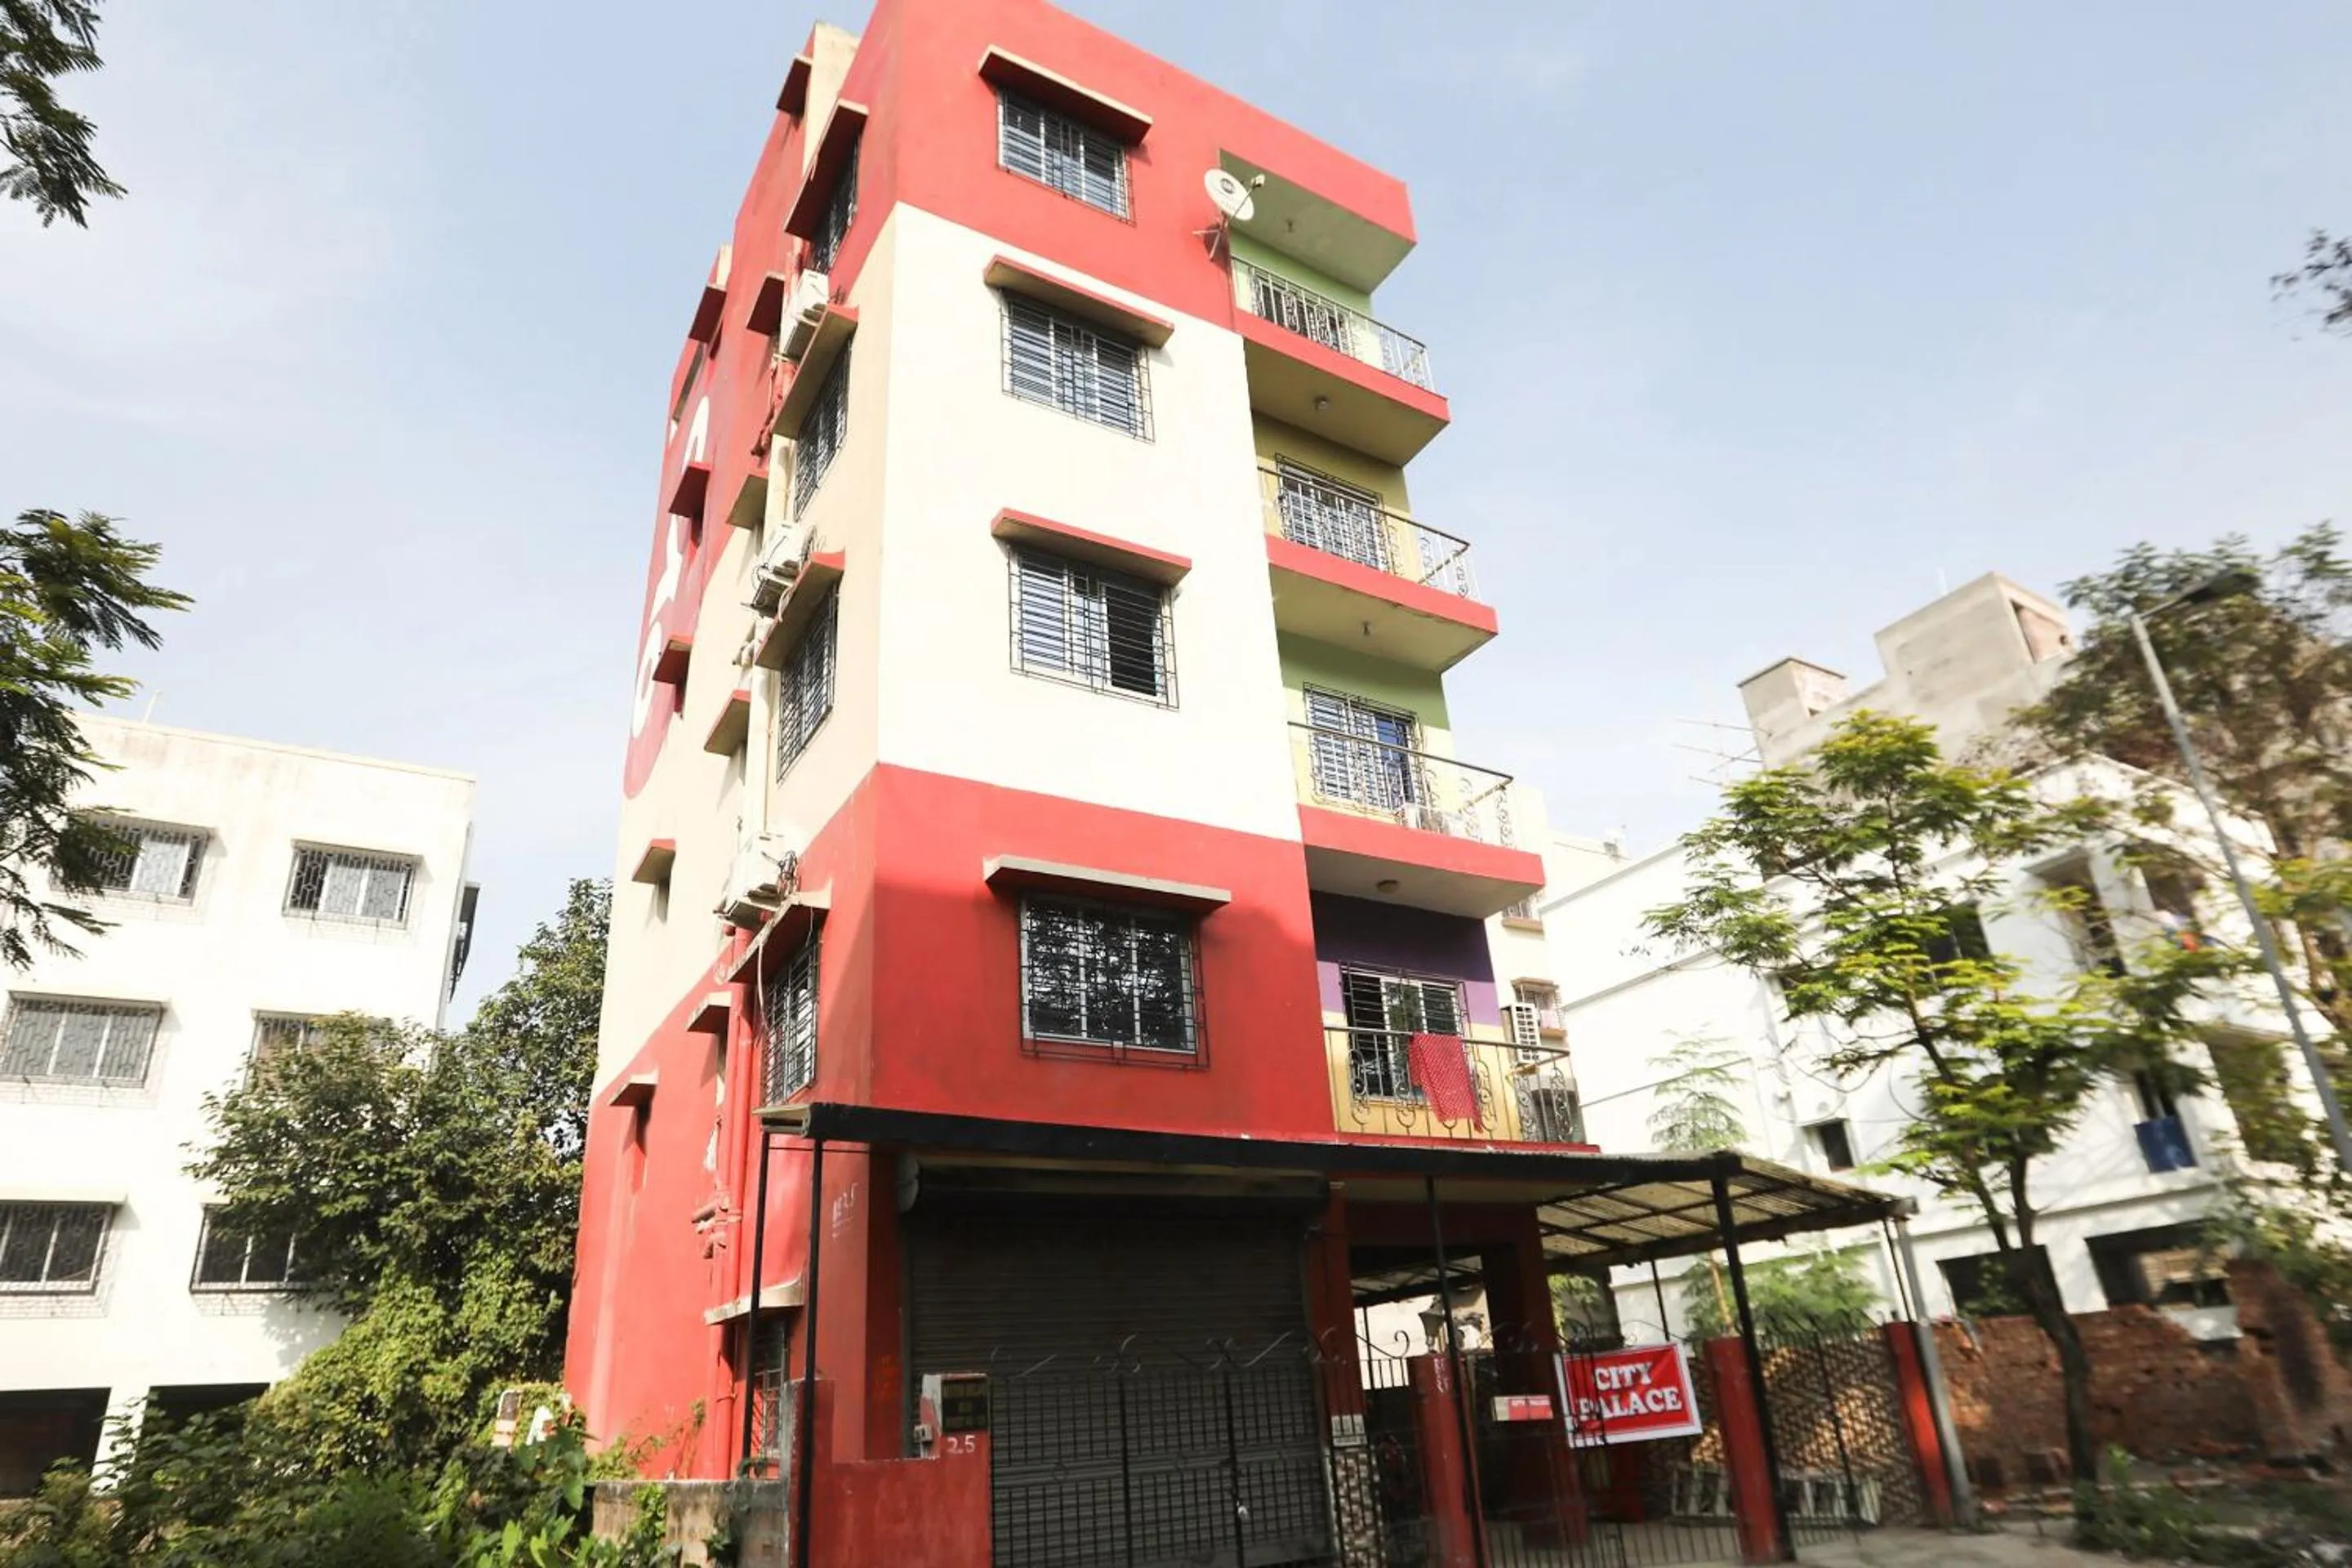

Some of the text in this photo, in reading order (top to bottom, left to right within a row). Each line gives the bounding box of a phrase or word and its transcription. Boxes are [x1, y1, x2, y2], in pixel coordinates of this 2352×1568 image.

[1594, 1361, 1654, 1392] CITY
[1578, 1386, 1683, 1422] PALACE
[947, 1433, 976, 1454] 25
